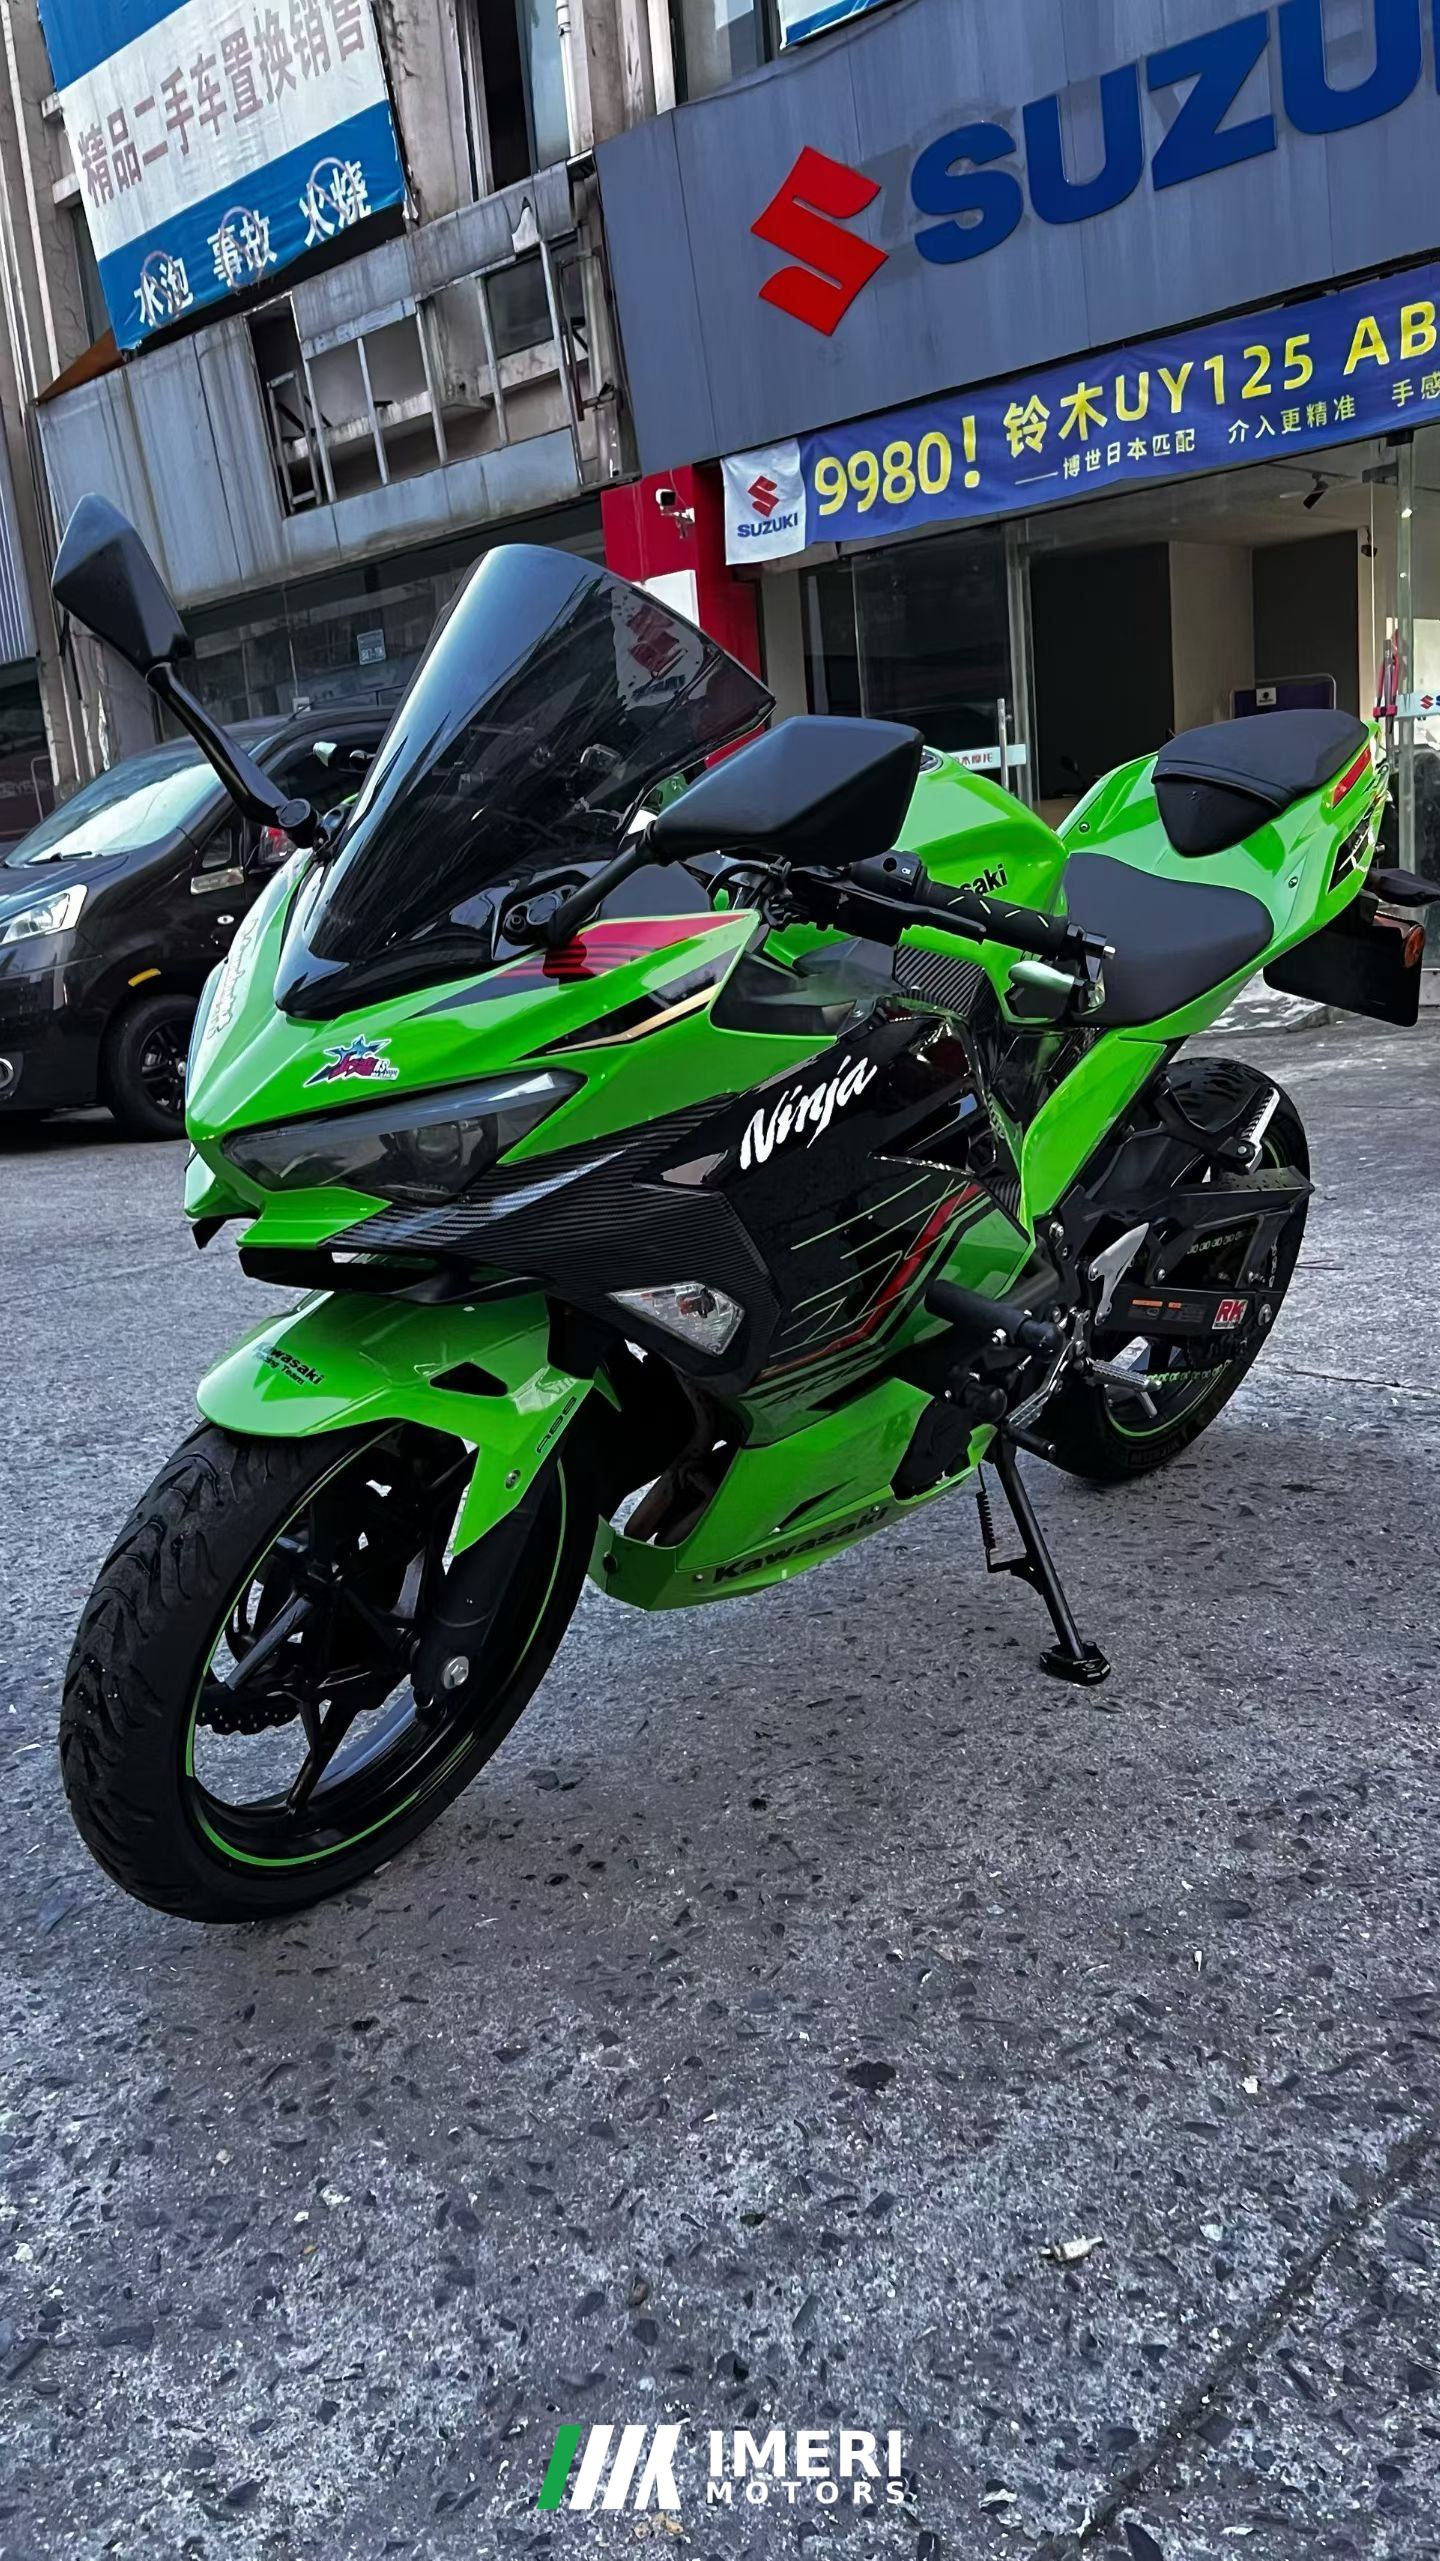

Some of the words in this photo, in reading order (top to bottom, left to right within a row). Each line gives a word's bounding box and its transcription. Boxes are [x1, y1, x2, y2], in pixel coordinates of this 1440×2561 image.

[910, 0, 1440, 265] SUZU
[134, 256, 193, 326] 水泡
[207, 210, 277, 287] 事故
[299, 160, 371, 247] 火烧
[1228, 394, 1356, 445] 介入更精准
[737, 512, 798, 538] SUZUKI
[740, 1055, 878, 1170] Ninja
[1215, 1300, 1246, 1323] RK
[281, 1365, 305, 1385] Team
[713, 1506, 889, 1584] Kawasaki
